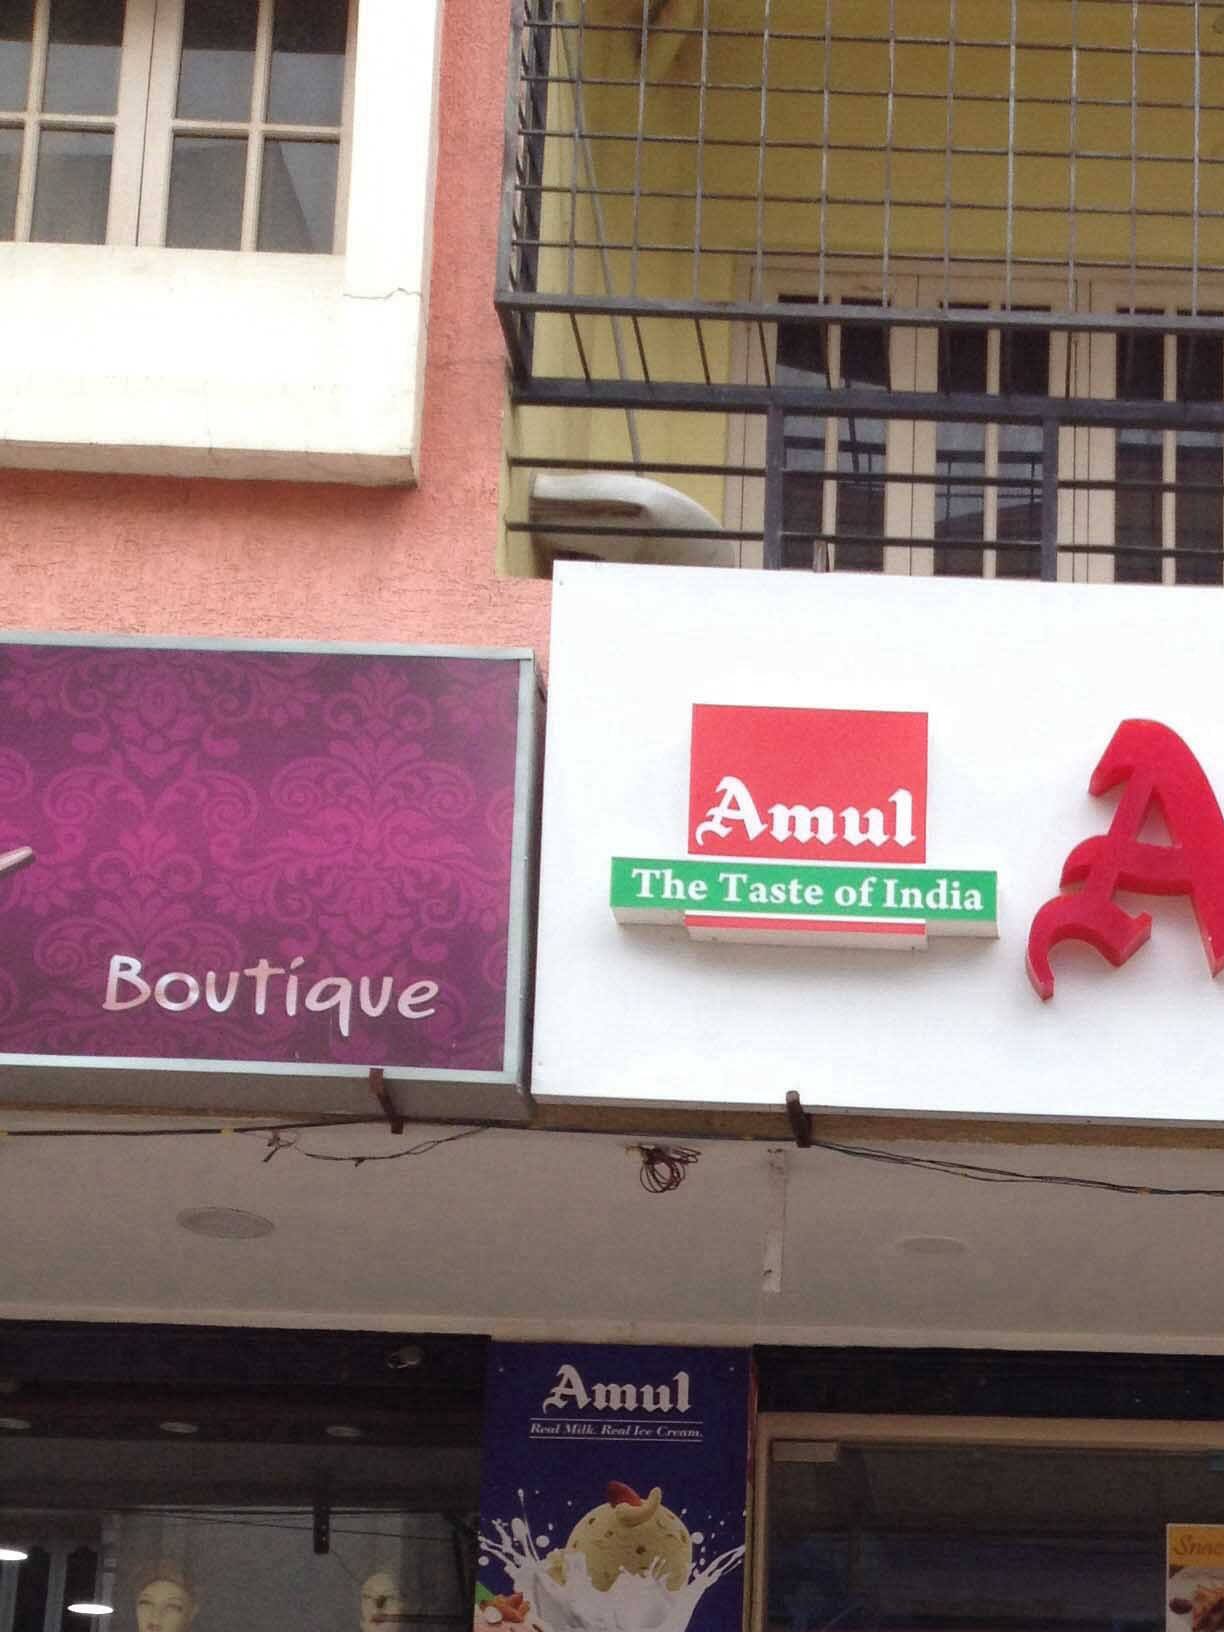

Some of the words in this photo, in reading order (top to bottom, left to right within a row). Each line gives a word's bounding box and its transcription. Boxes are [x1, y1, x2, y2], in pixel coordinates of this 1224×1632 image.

[694, 776, 918, 848] Amul
[631, 866, 709, 903] The
[717, 870, 826, 906] Taste
[834, 873, 878, 908] of
[883, 876, 983, 913] India
[102, 953, 440, 1036] Boutique
[542, 1363, 692, 1415] Amul
[530, 1422, 561, 1435] Real
[601, 1424, 631, 1436] Real
[633, 1425, 655, 1437] Ice
